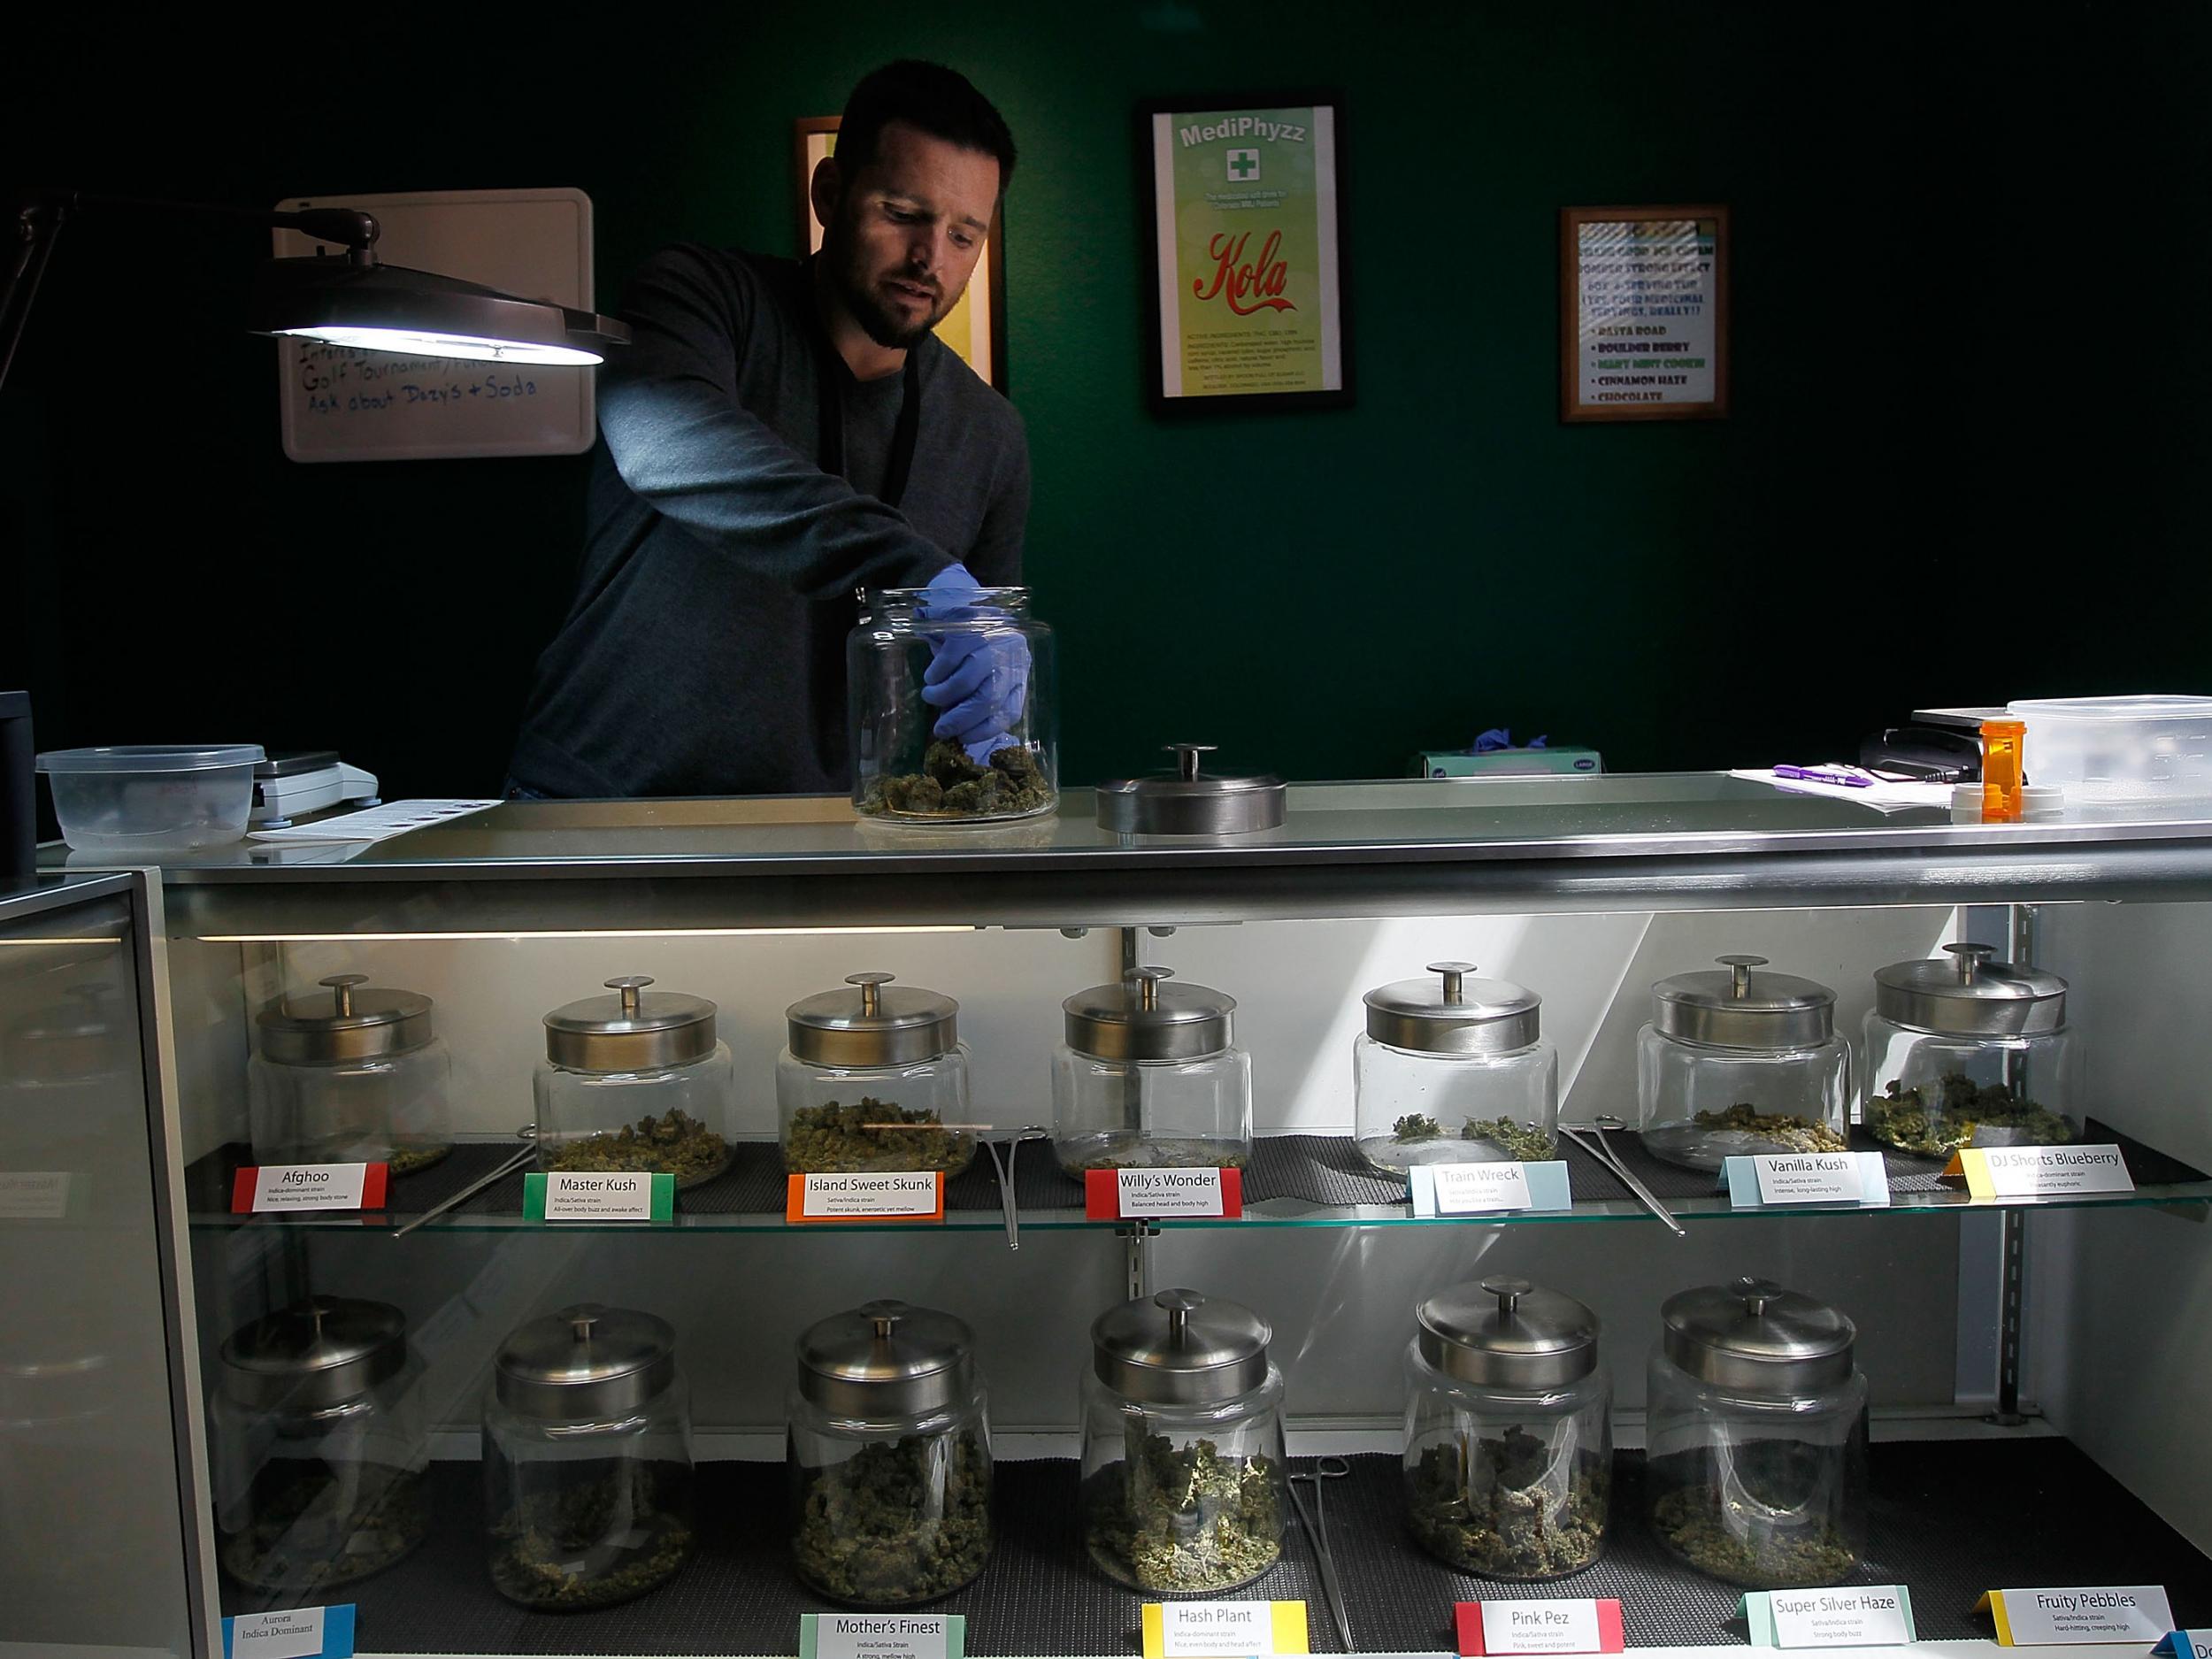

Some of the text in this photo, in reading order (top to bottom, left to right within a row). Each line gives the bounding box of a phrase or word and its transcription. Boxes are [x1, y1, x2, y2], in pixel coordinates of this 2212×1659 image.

[1179, 117, 1307, 148] MediPhyzz
[1194, 229, 1298, 316] Kola
[1598, 326, 1667, 336] RASTA ROAD
[1598, 342, 1689, 353] BOULDER BERRY
[485, 373, 536, 399] Soda
[1598, 375, 1687, 387] CINNAMON HAZE
[1598, 393, 1663, 402] CHOCOLATE
[1768, 1156, 1849, 1173] Vanilla Kush
[1992, 1151, 2119, 1168] DJ Shorts Blueberry
[282, 1171, 330, 1186] Afghoo
[1120, 1173, 1217, 1190] Willy's Wonder
[1442, 1168, 1521, 1184] Train Wreck
[560, 1178, 637, 1191] Master Kush
[810, 1177, 933, 1192] Island Sweet Skunk
[320, 1194, 333, 1203] body
[1182, 1200, 1195, 1209] body
[1196, 1199, 1210, 1208] high
[1777, 1595, 1896, 1616] Super Silver Haze
[2037, 1593, 2136, 1611] Fruity Pebbles
[261, 1616, 292, 1625] Aurora
[1179, 1609, 1253, 1623] Hash Plant
[1512, 1610, 1570, 1625] Pink Pez
[242, 1624, 313, 1640] Indica Dominant
[836, 1618, 941, 1635] Mother's Finest
[1813, 1630, 1832, 1639] Strong
